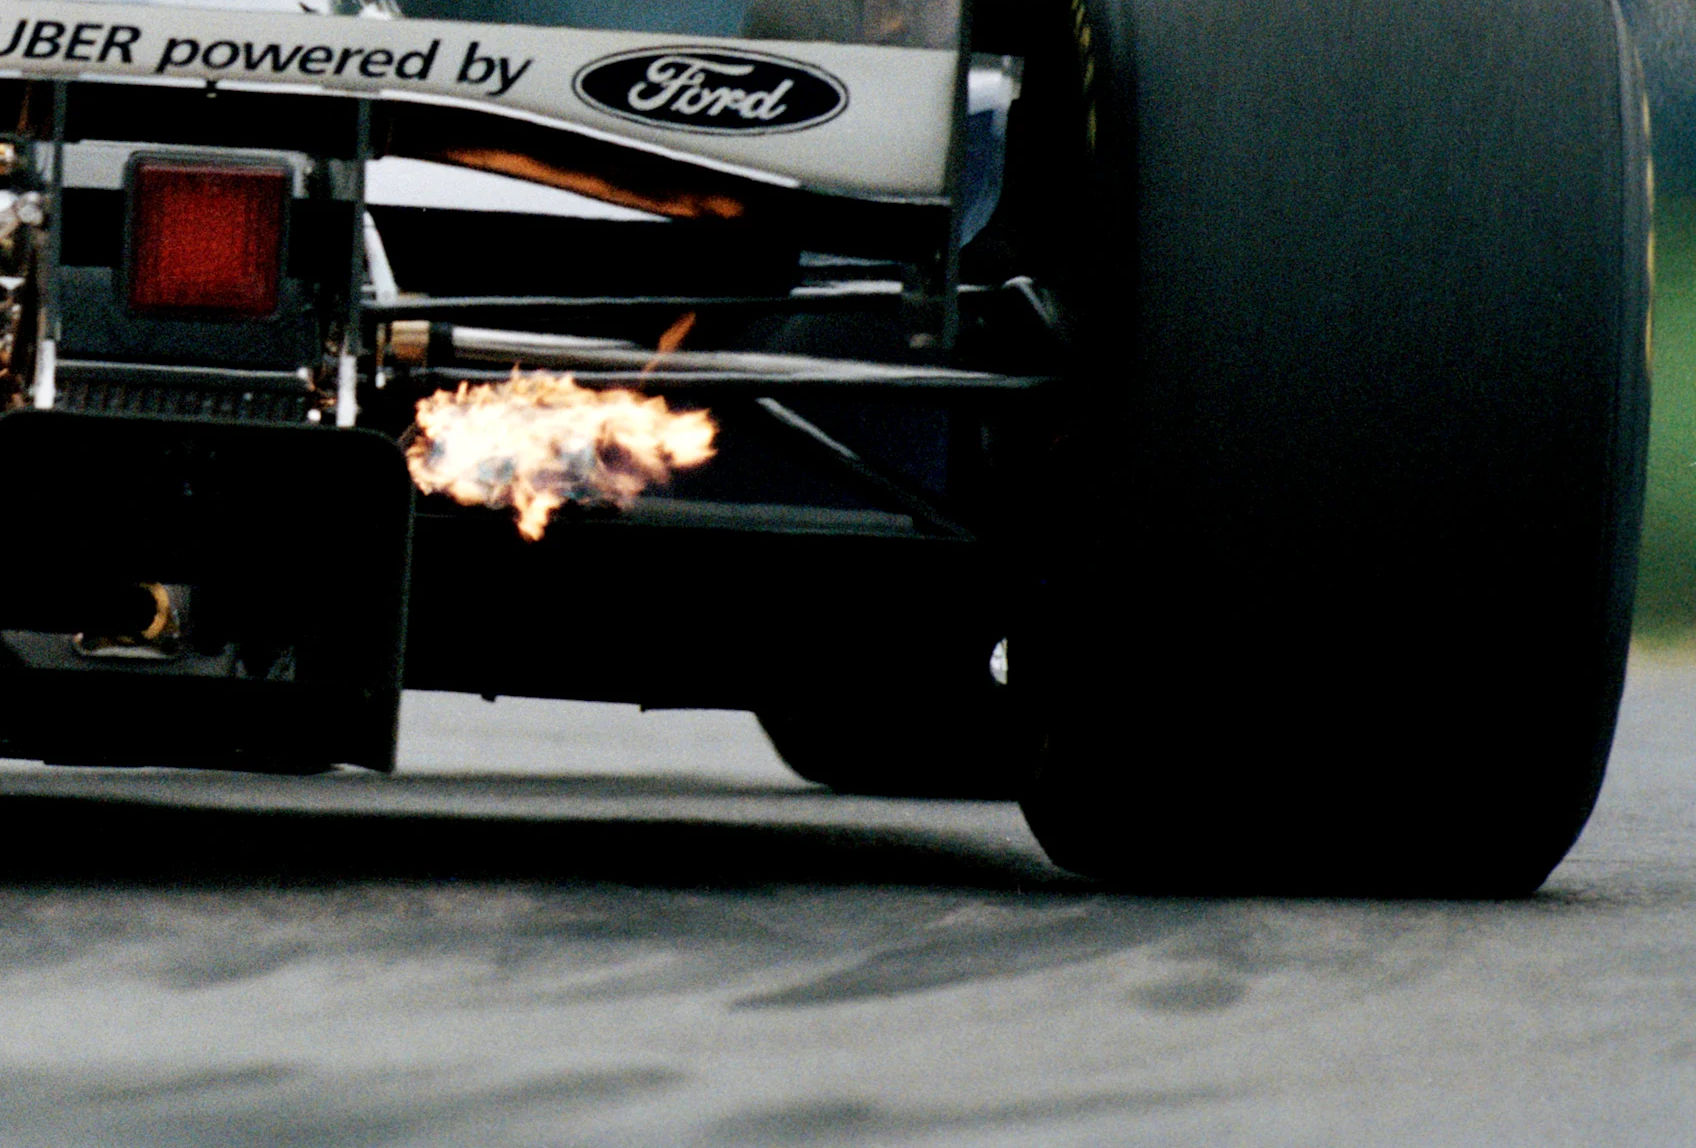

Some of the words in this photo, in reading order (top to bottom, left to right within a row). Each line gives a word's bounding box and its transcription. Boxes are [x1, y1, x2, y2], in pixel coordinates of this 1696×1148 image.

[152, 39, 441, 82] powered
[455, 40, 532, 100] by
[628, 55, 793, 119] Ford
